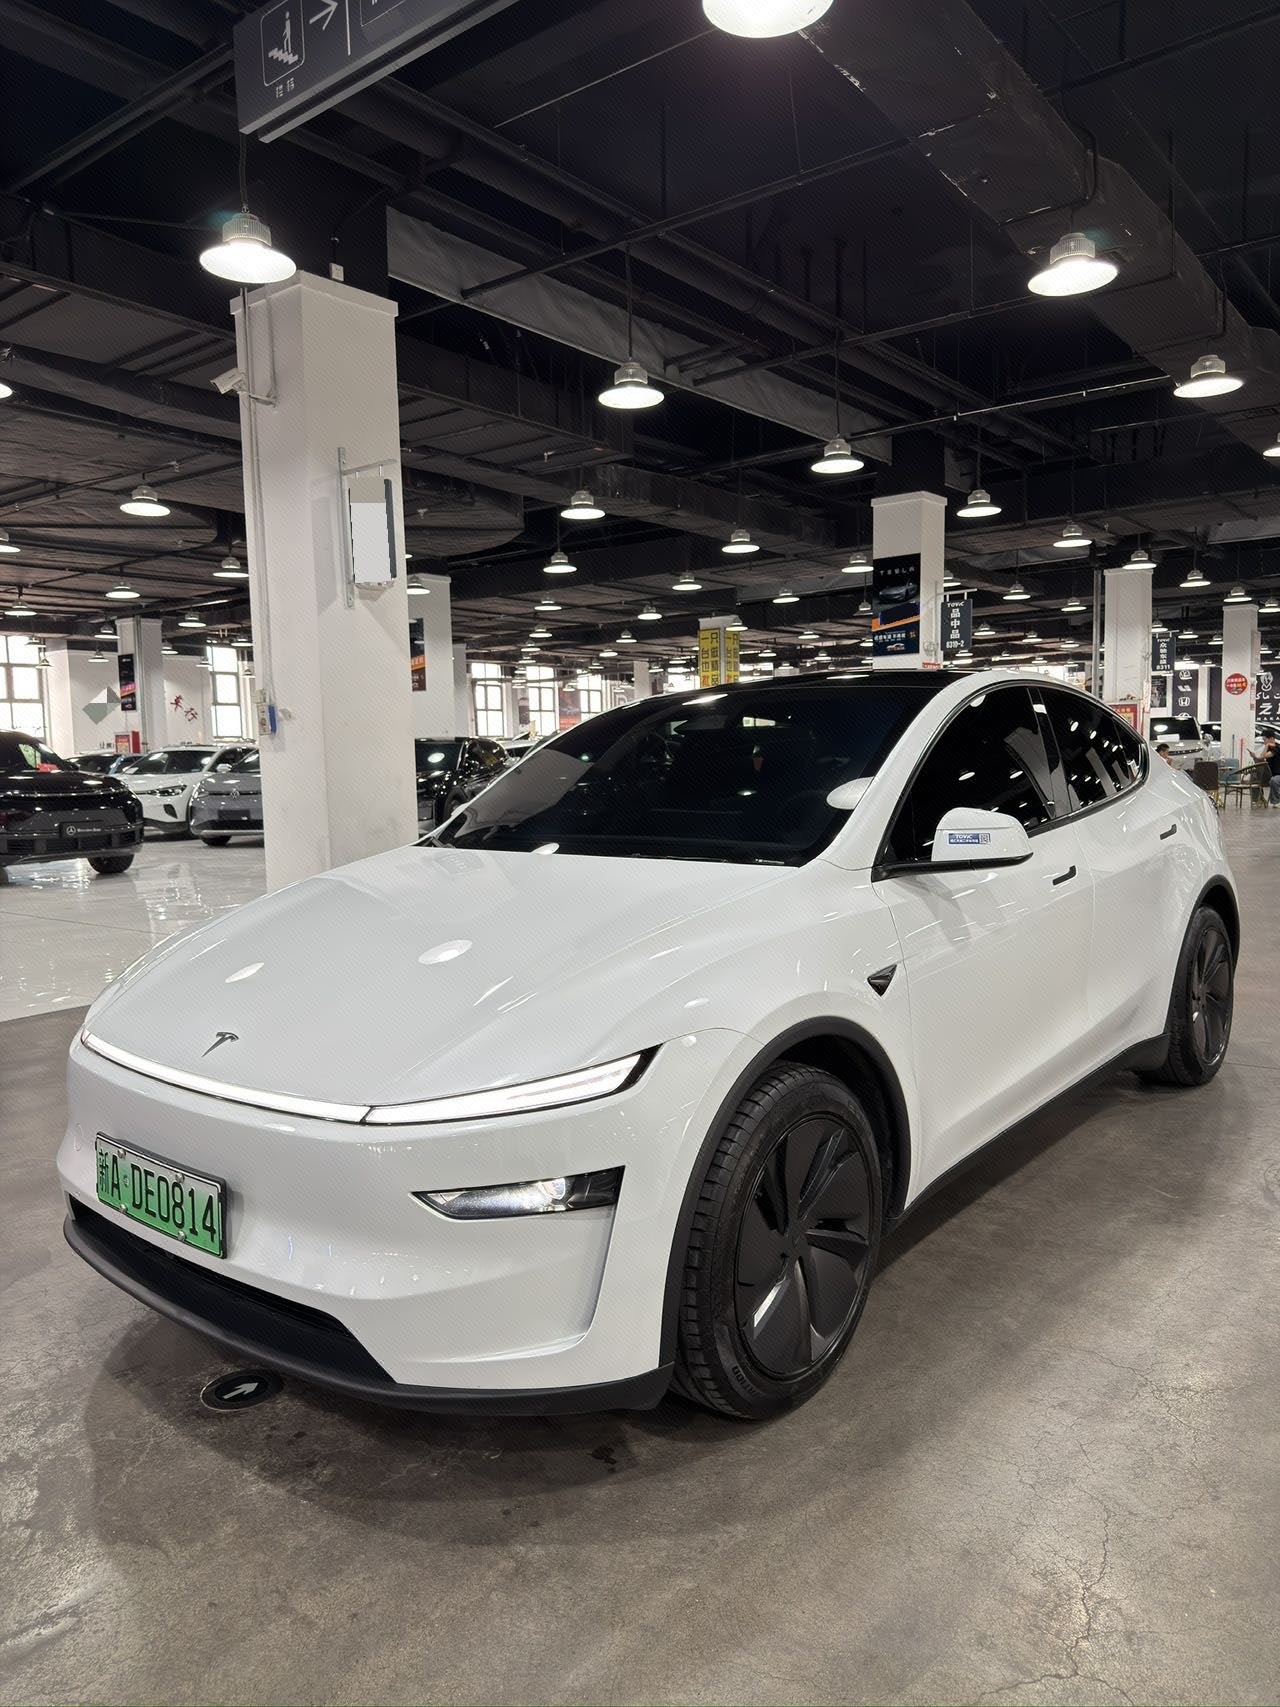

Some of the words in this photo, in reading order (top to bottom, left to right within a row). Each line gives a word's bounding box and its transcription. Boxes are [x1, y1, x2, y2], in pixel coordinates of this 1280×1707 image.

[880, 566, 915, 576] TESLA
[950, 608, 961, 639] 品中品
[131, 1163, 217, 1243] DE0814
